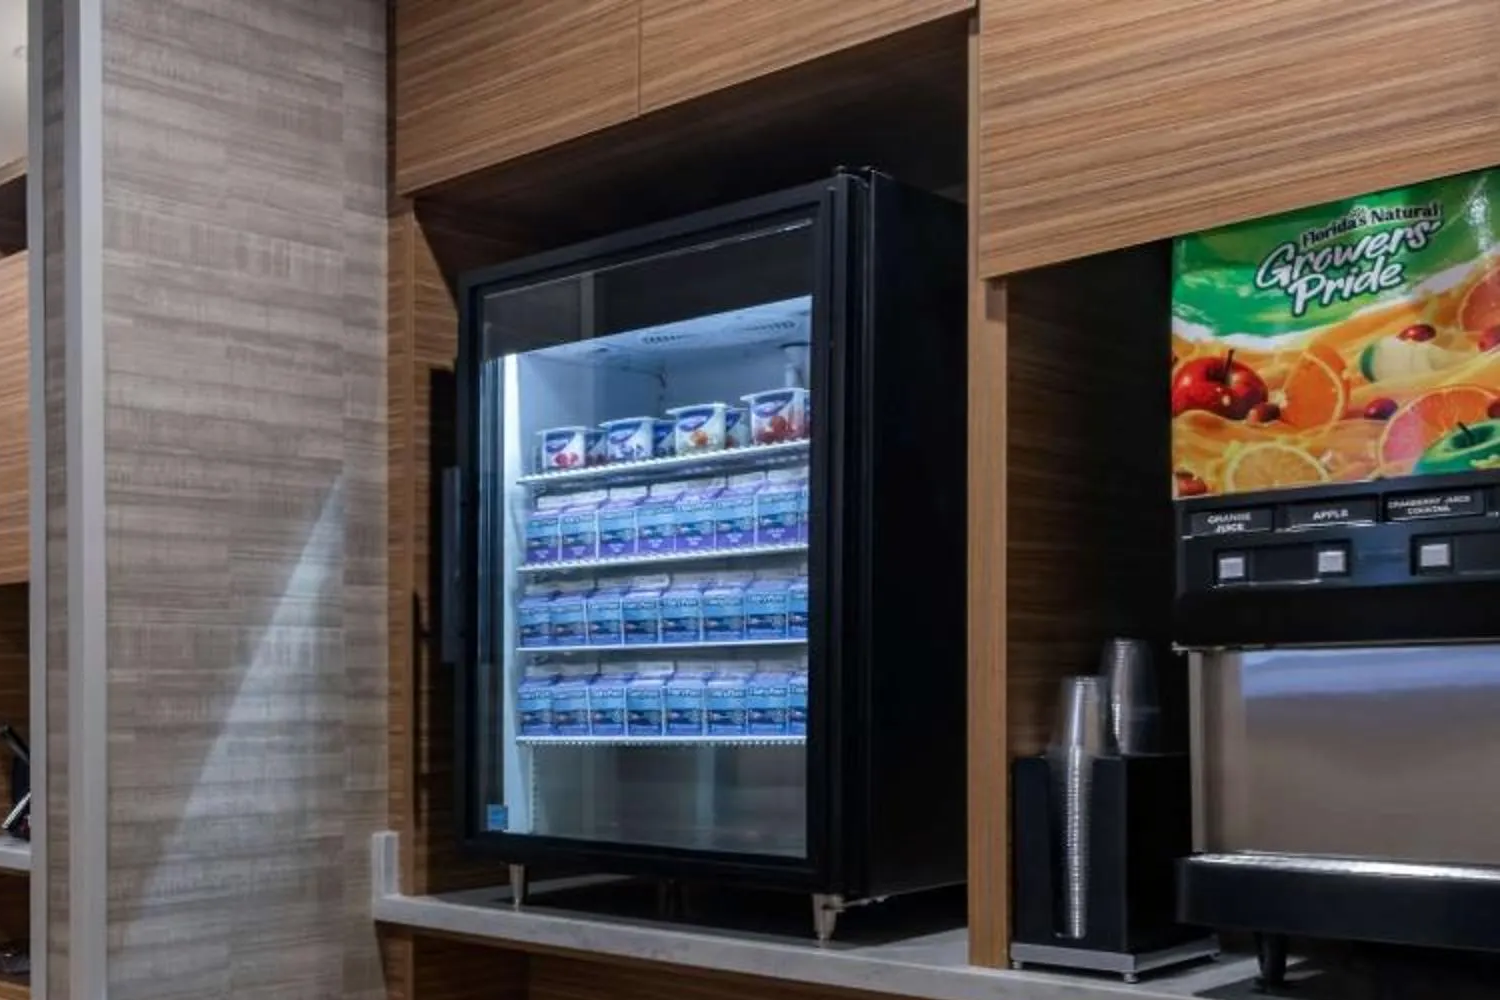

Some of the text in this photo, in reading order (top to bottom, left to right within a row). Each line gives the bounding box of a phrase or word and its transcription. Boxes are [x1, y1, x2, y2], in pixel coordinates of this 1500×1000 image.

[1303, 204, 1439, 246] Florida's Natural
[1288, 255, 1405, 316] Pride
[1312, 508, 1349, 520] APPLE
